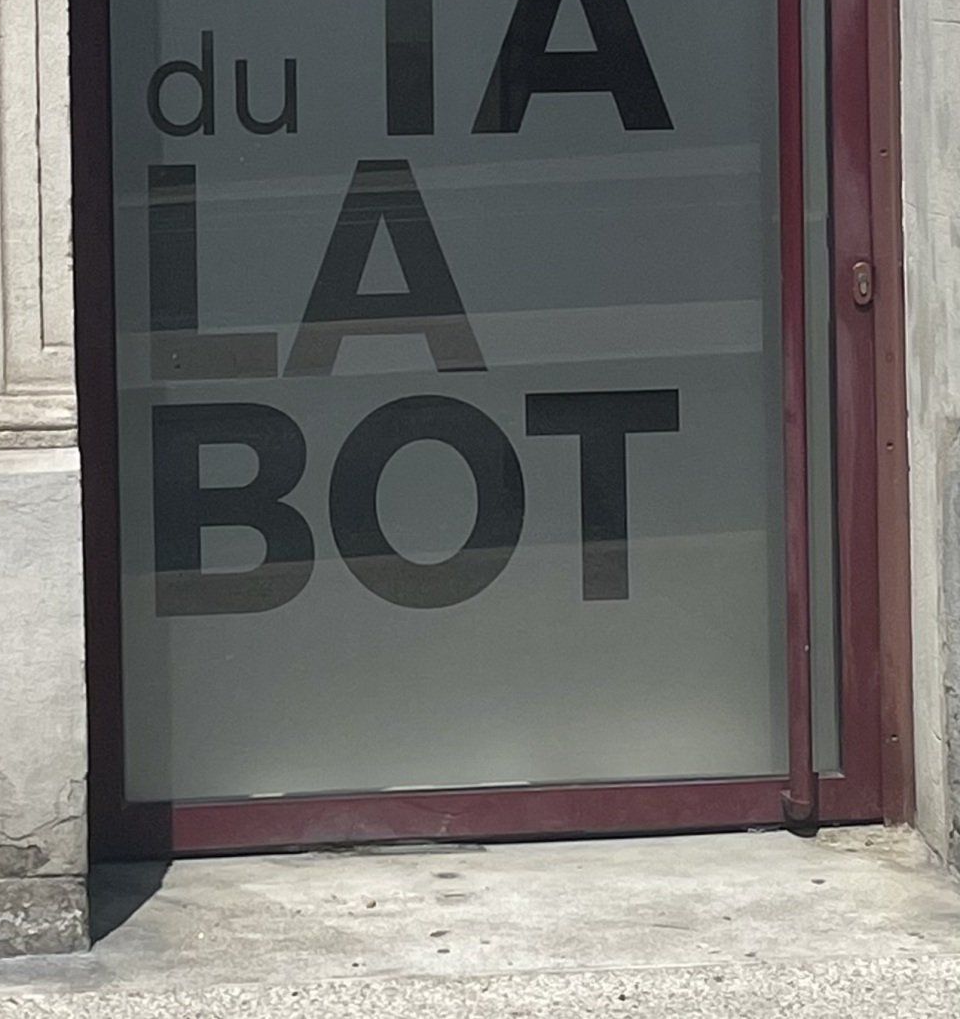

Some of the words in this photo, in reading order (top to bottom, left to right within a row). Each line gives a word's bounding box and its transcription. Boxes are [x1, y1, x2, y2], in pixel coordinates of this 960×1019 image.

[146, 30, 298, 136] du
[148, 159, 489, 381] LA
[151, 388, 680, 618] BOT
